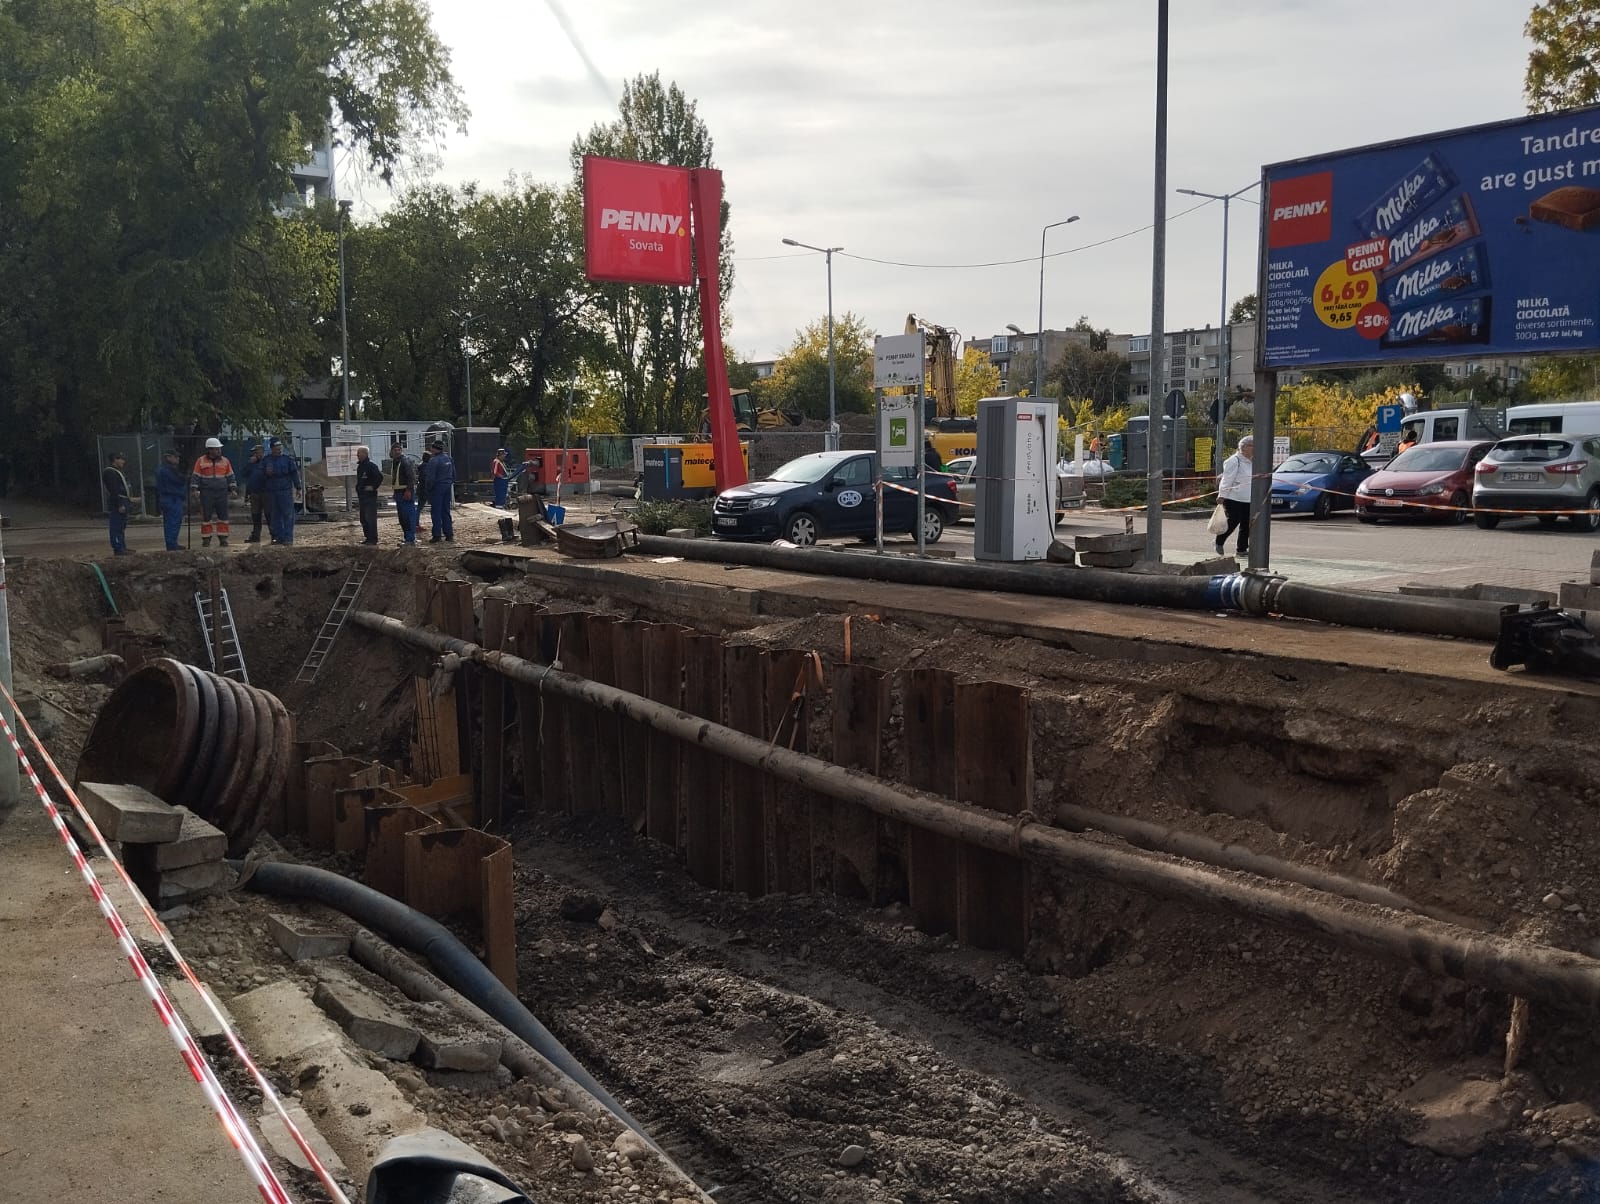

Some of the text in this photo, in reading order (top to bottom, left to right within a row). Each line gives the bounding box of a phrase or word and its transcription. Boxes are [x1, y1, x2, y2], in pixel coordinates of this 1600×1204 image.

[1480, 172, 1516, 191] are
[1523, 160, 1574, 190] gust
[1376, 174, 1425, 231] Milka
[629, 239, 663, 252] Sovata
[1389, 217, 1440, 262] Milka
[1347, 240, 1385, 259] PENNY
[1269, 261, 1293, 271] MILKA
[1352, 255, 1383, 272] CARD
[1395, 260, 1453, 300] Milka
[1321, 280, 1369, 304] 6,69
[1516, 298, 1549, 308] MILKA
[1330, 312, 1352, 323] 9,65
[1358, 314, 1388, 327] -30%
[1396, 304, 1456, 337] Milka
[1515, 321, 1545, 330] diverse
[1383, 408, 1395, 424] P
